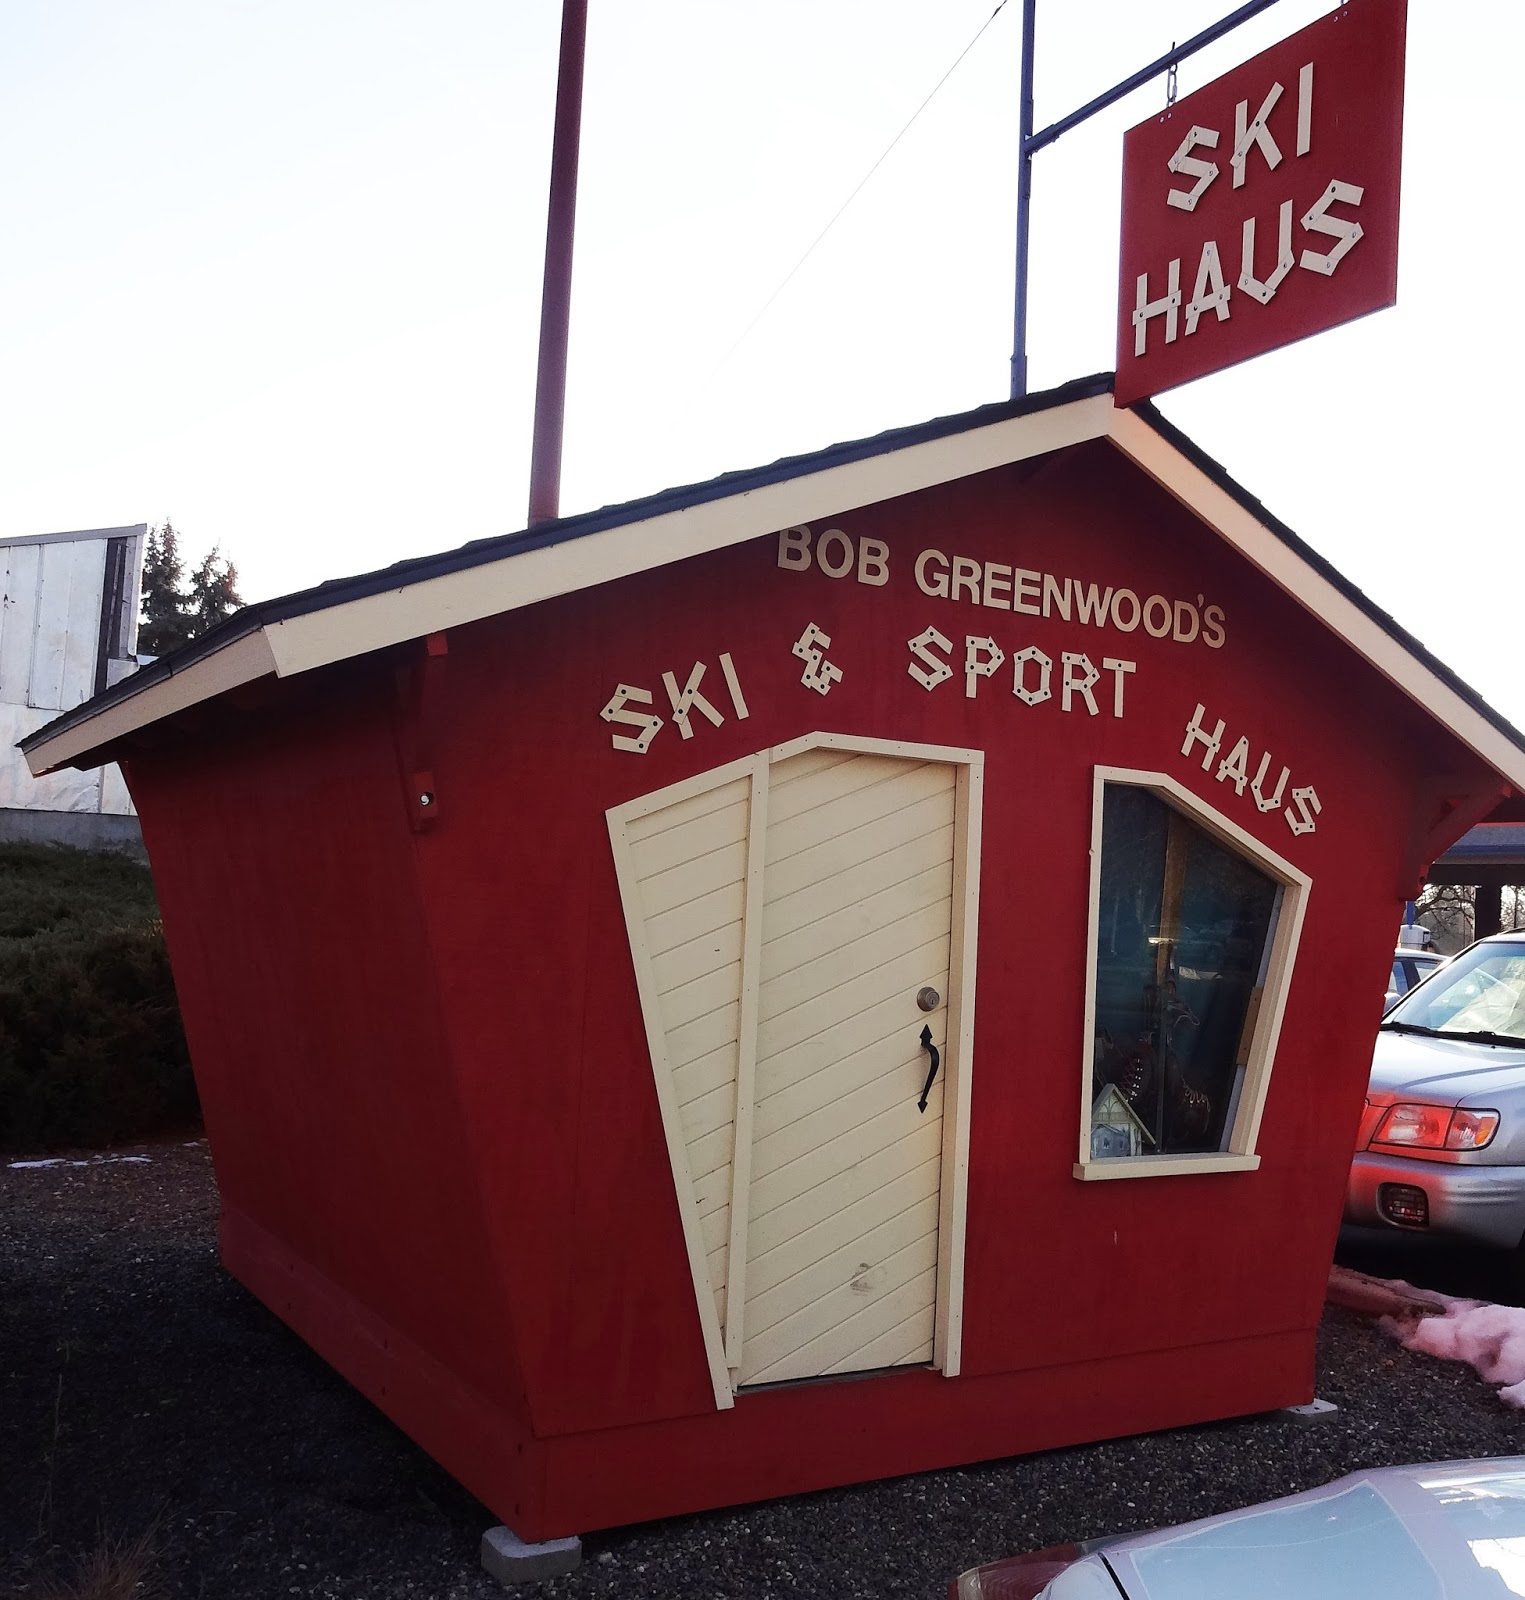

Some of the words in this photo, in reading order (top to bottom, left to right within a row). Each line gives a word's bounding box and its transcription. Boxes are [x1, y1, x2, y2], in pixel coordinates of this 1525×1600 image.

[1166, 61, 1314, 212] SKI
[1132, 178, 1365, 357] HAUS
[777, 524, 891, 587] BOB
[914, 548, 1227, 649] GREENWOOD'S
[599, 652, 750, 755] SKI
[791, 621, 844, 697] &
[907, 624, 1138, 719] SPORT
[1180, 702, 1323, 837] HAUS
